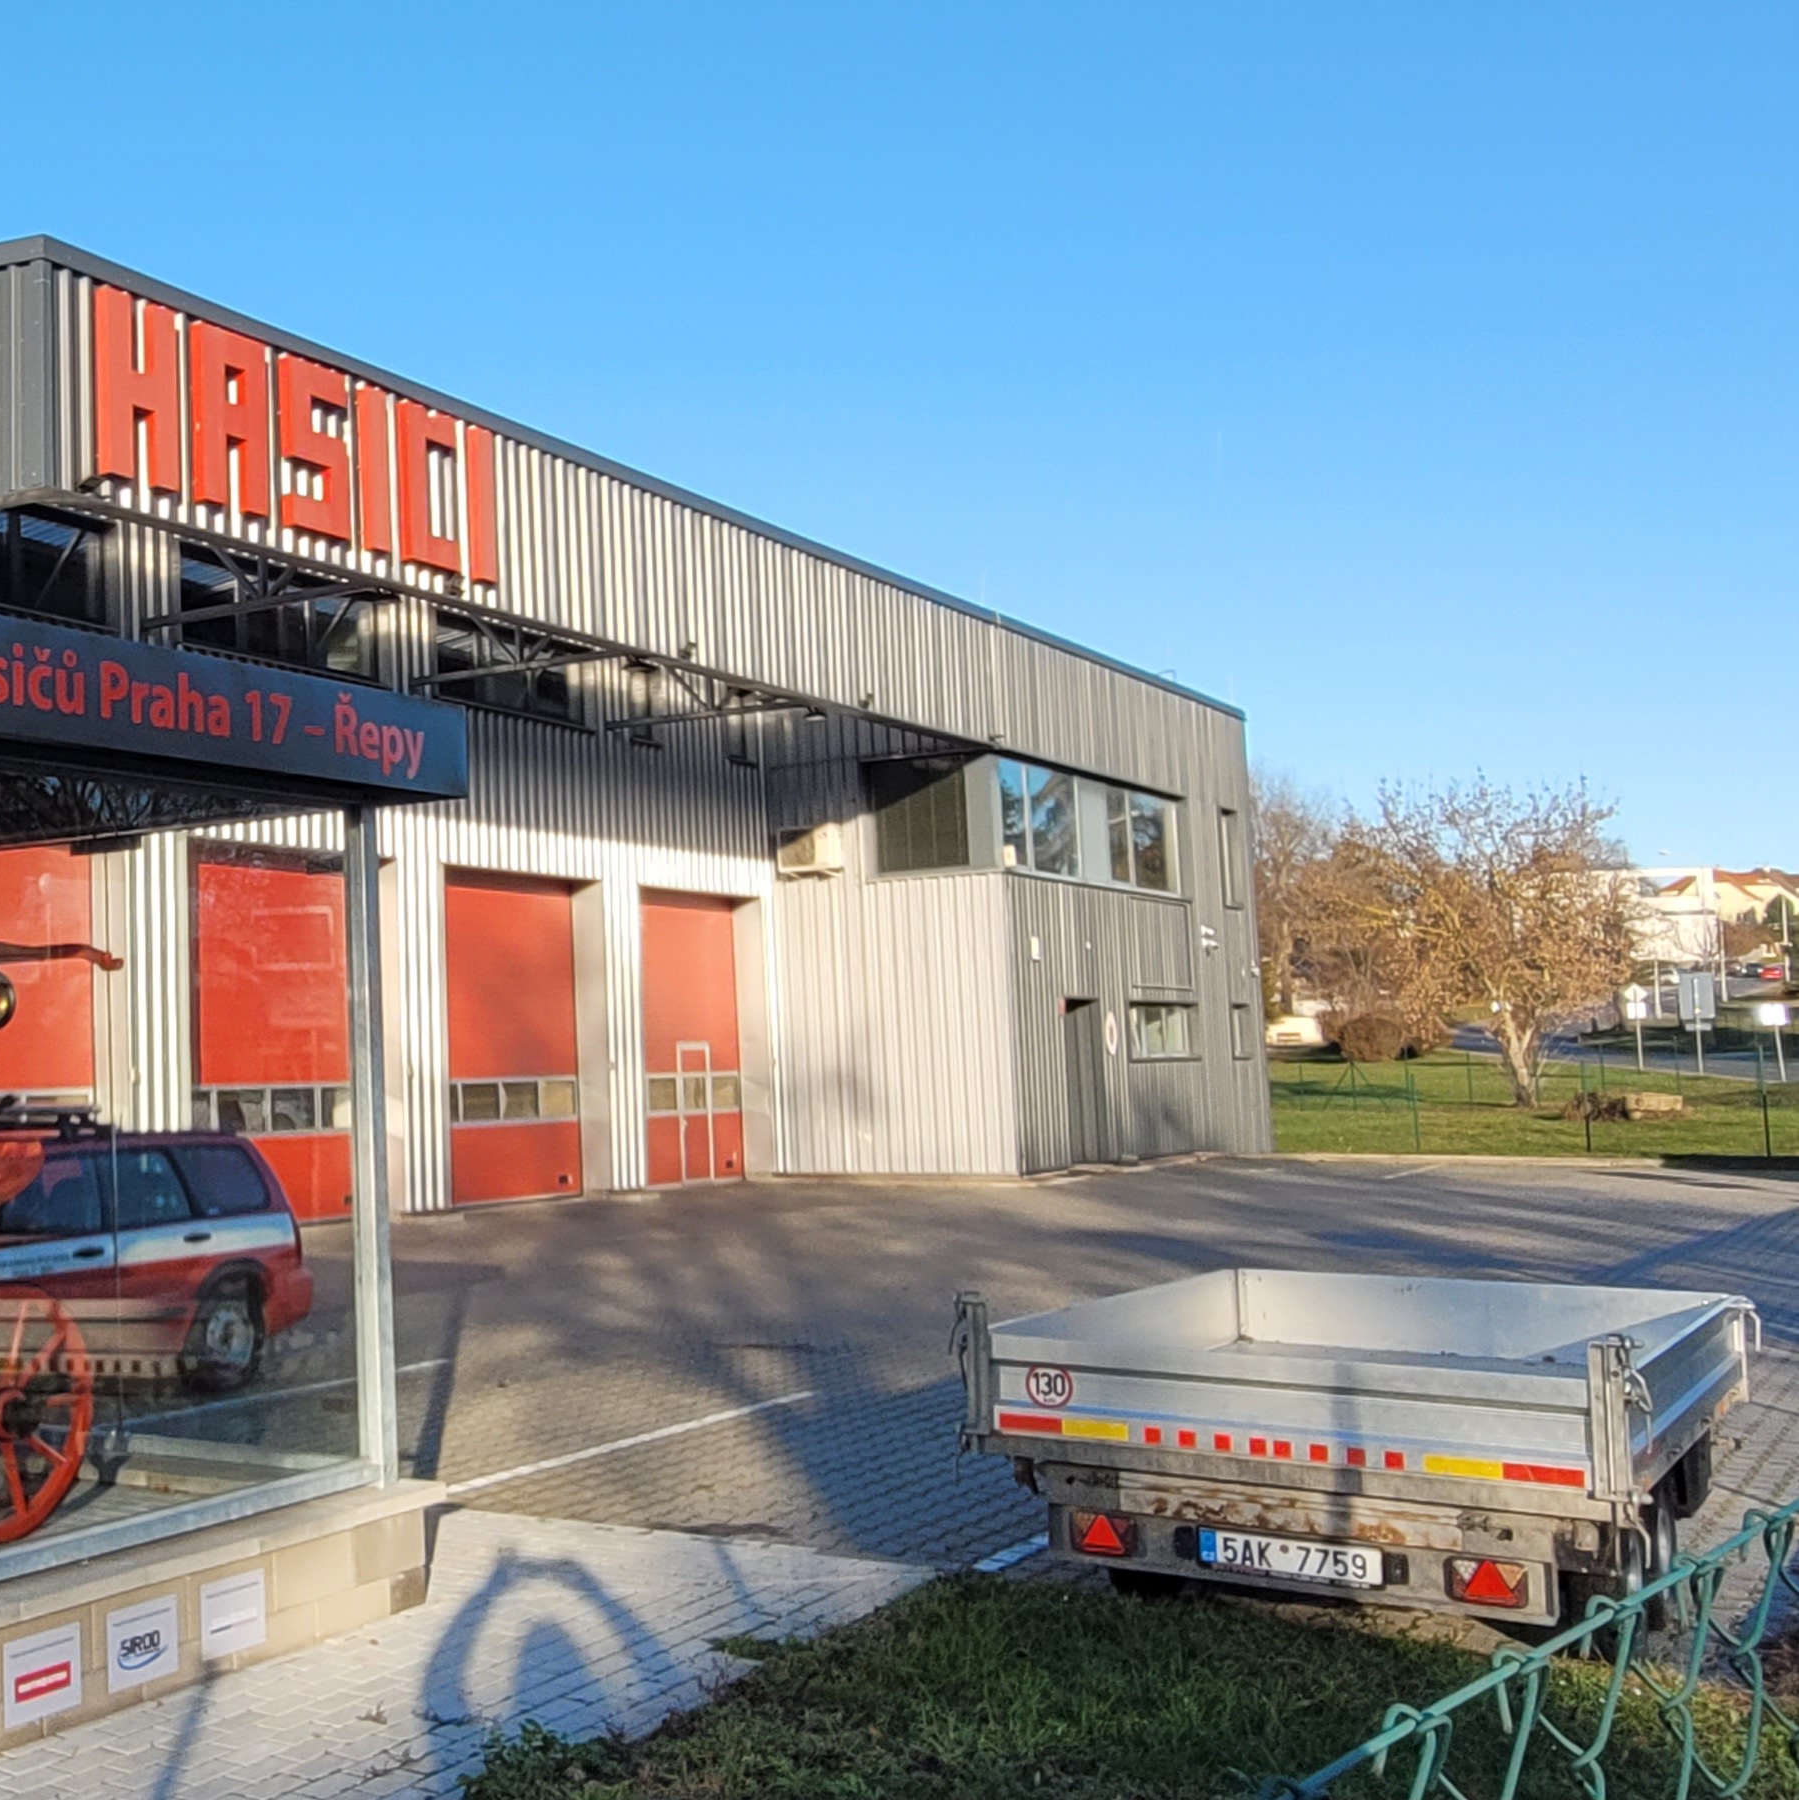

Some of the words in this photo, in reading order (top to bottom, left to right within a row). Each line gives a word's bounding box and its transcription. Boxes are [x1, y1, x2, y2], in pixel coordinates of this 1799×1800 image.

[95, 284, 497, 584] HASICI
[100, 660, 232, 738] Praha
[244, 690, 292, 745] 17
[334, 691, 425, 780] Řepy
[1032, 1372, 1066, 1397] 130
[1222, 1536, 1272, 1569] 5AK
[1296, 1545, 1368, 1580] 7759
